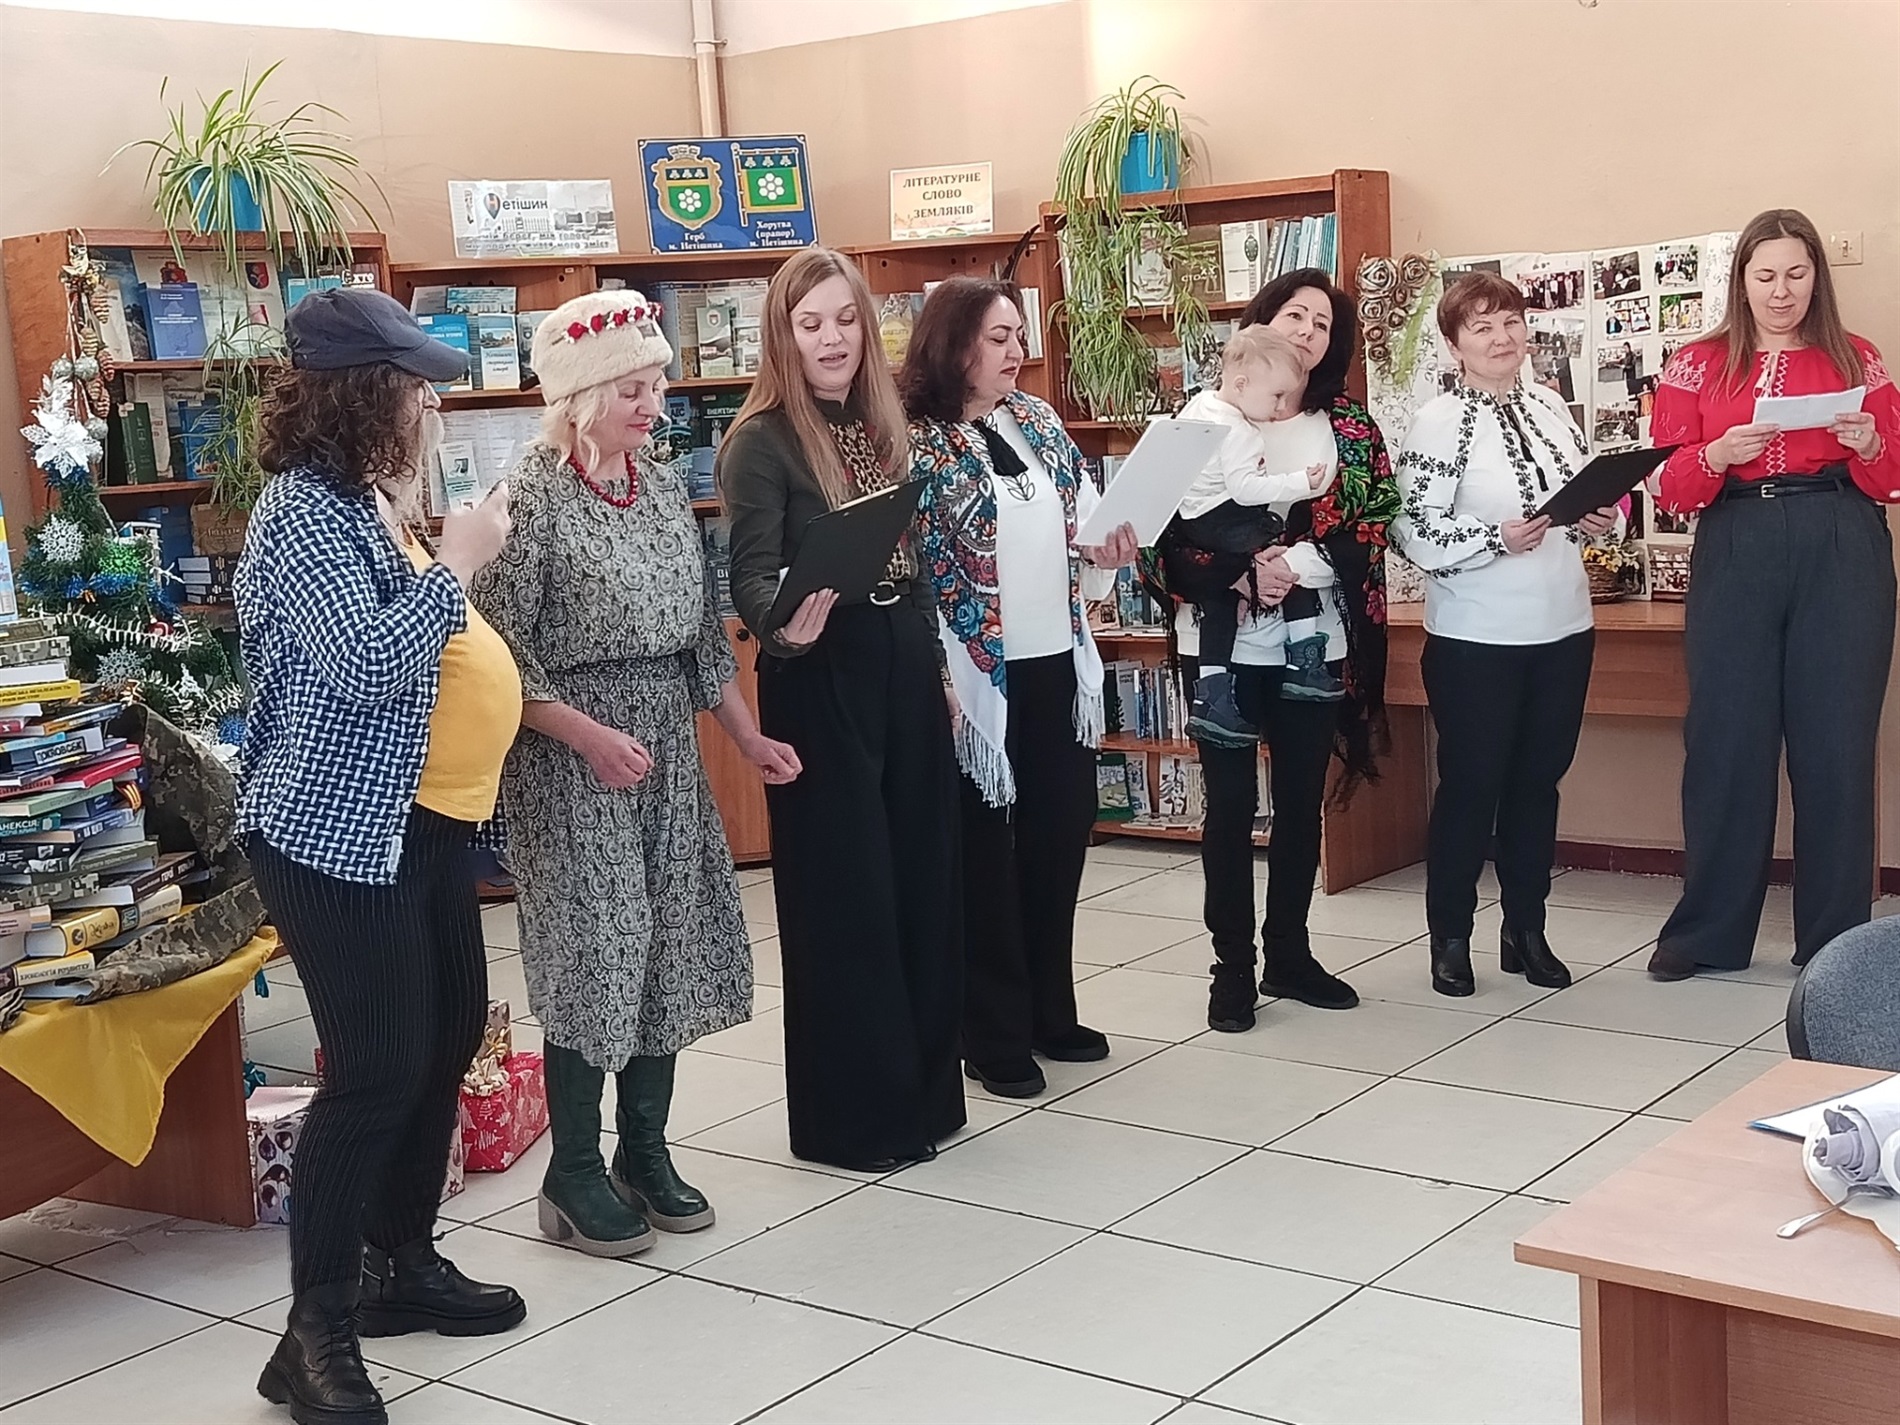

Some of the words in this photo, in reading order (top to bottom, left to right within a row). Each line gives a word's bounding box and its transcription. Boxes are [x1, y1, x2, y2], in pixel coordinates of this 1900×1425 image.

[903, 172, 981, 188] ЛІТЕРАТУРНЕ
[922, 189, 962, 201] СЛОВО
[913, 205, 974, 218] ЗЕМЛЯКІВ
[756, 221, 792, 231] Хоругва
[684, 232, 705, 242] Герб
[755, 230, 795, 240] (прапор)
[680, 241, 723, 250] Нетішина
[750, 240, 759, 248] м.
[762, 237, 803, 247] Нетішина
